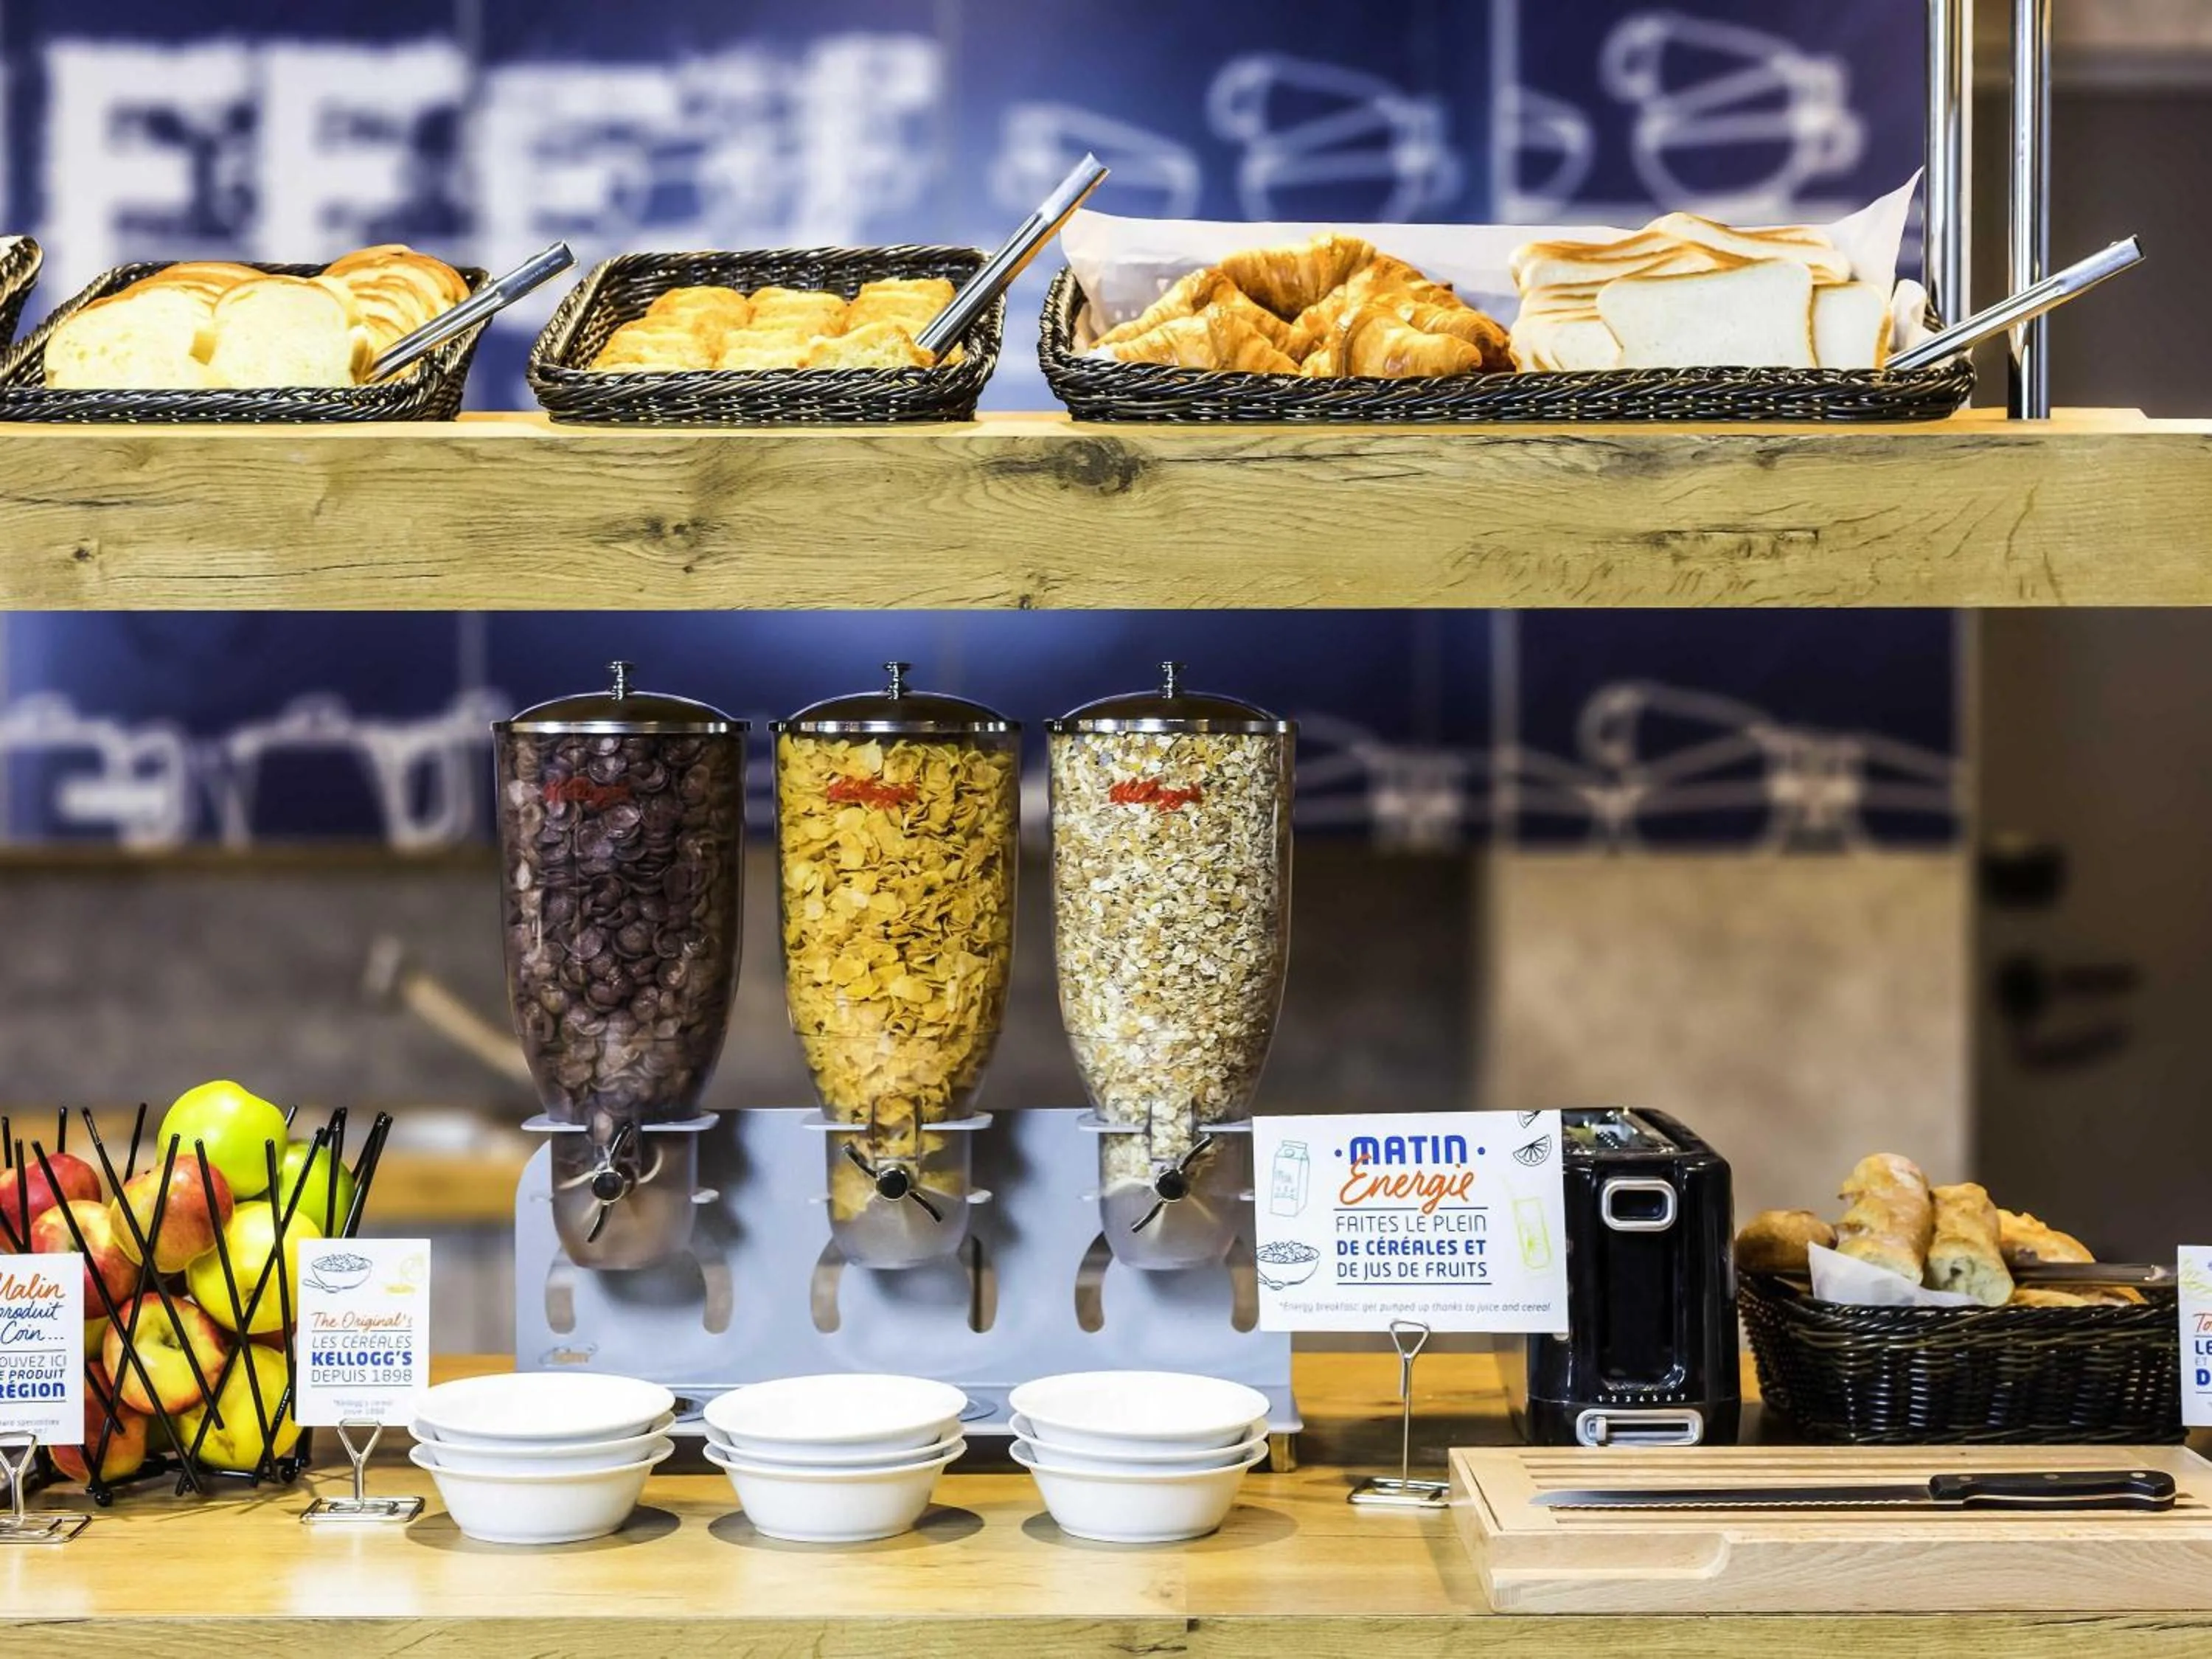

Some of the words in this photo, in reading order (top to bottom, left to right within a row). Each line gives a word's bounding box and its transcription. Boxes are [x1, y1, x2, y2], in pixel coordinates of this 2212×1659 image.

[1350, 1135, 1467, 1165] MATIN
[1340, 1153, 1474, 1214] Energie
[1336, 1216, 1399, 1232] FAITES
[1405, 1216, 1426, 1232] LE
[1433, 1215, 1486, 1232] PLEIN
[1337, 1239, 1359, 1255] DE
[1366, 1236, 1458, 1255] CÉRÉALES
[1464, 1239, 1486, 1255] ET
[1337, 1262, 1357, 1277] DE
[1364, 1262, 1391, 1281] JUS
[1398, 1262, 1418, 1277] DE
[1425, 1262, 1487, 1277] FRUITS
[1418, 1304, 1430, 1313] up
[1502, 1302, 1519, 1312] and
[310, 1312, 337, 1327] The
[312, 1335, 337, 1349] LES
[51, 1354, 66, 1367] ICI
[312, 1351, 412, 1366] KELLOGG'S
[9, 1368, 65, 1380] PRODUIT
[312, 1369, 366, 1382] DEPUIS
[372, 1368, 412, 1382] 1898
